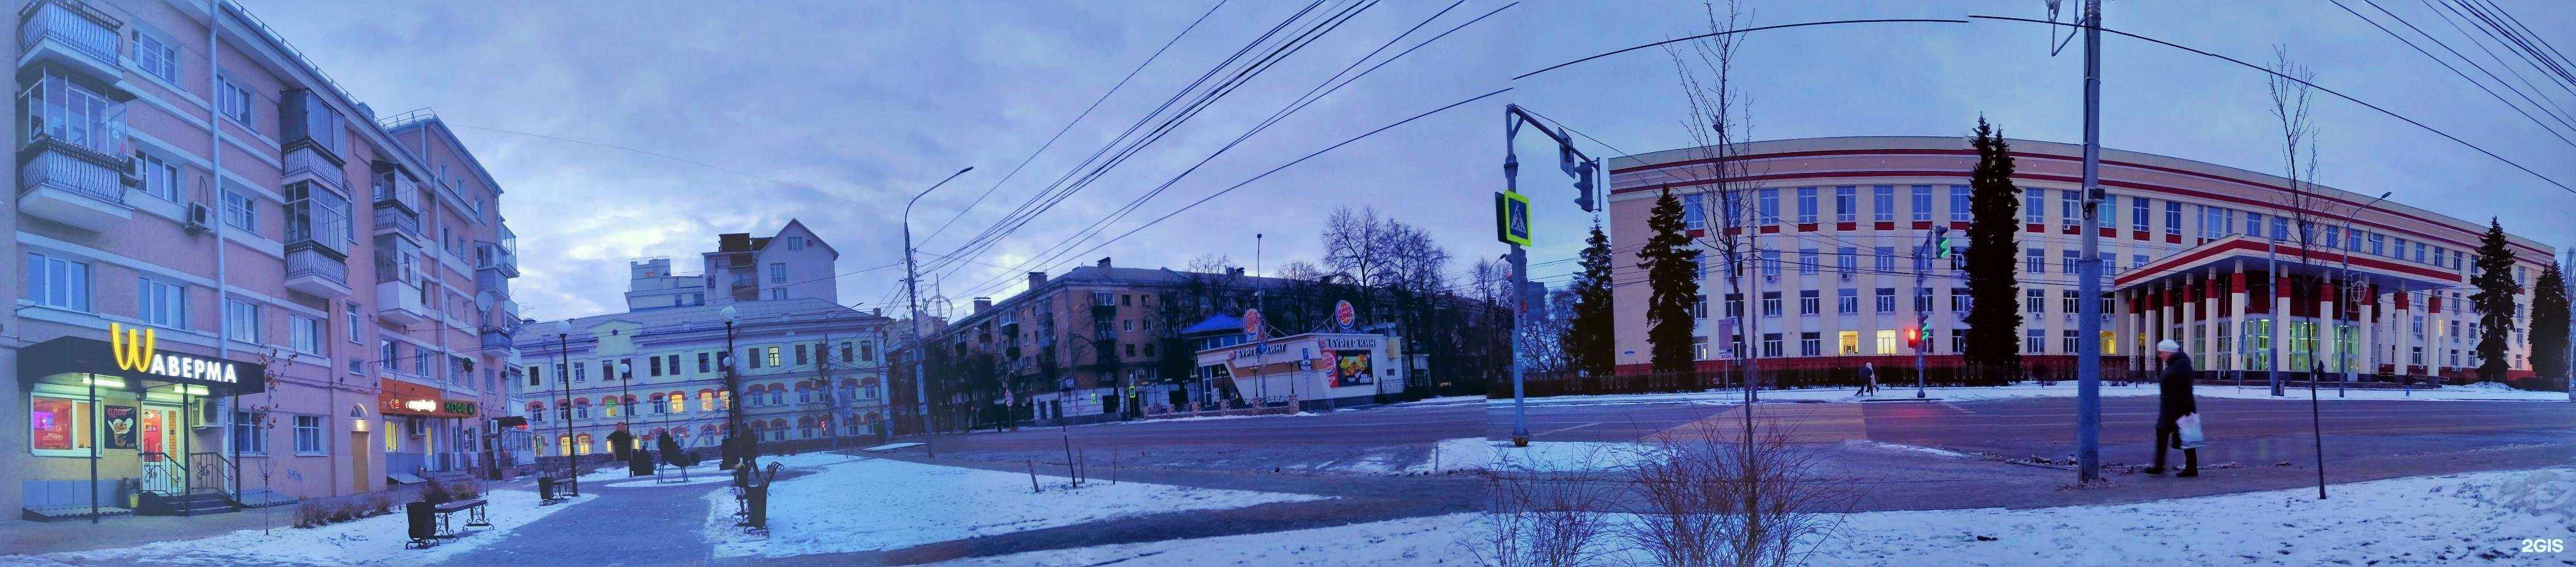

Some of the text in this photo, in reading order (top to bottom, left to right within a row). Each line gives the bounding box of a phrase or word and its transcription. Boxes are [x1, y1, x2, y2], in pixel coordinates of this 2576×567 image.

[1330, 339, 1357, 347] БУРГЕР
[1236, 347, 1260, 358] БУРГЕ
[446, 402, 468, 414] КОФЕ
